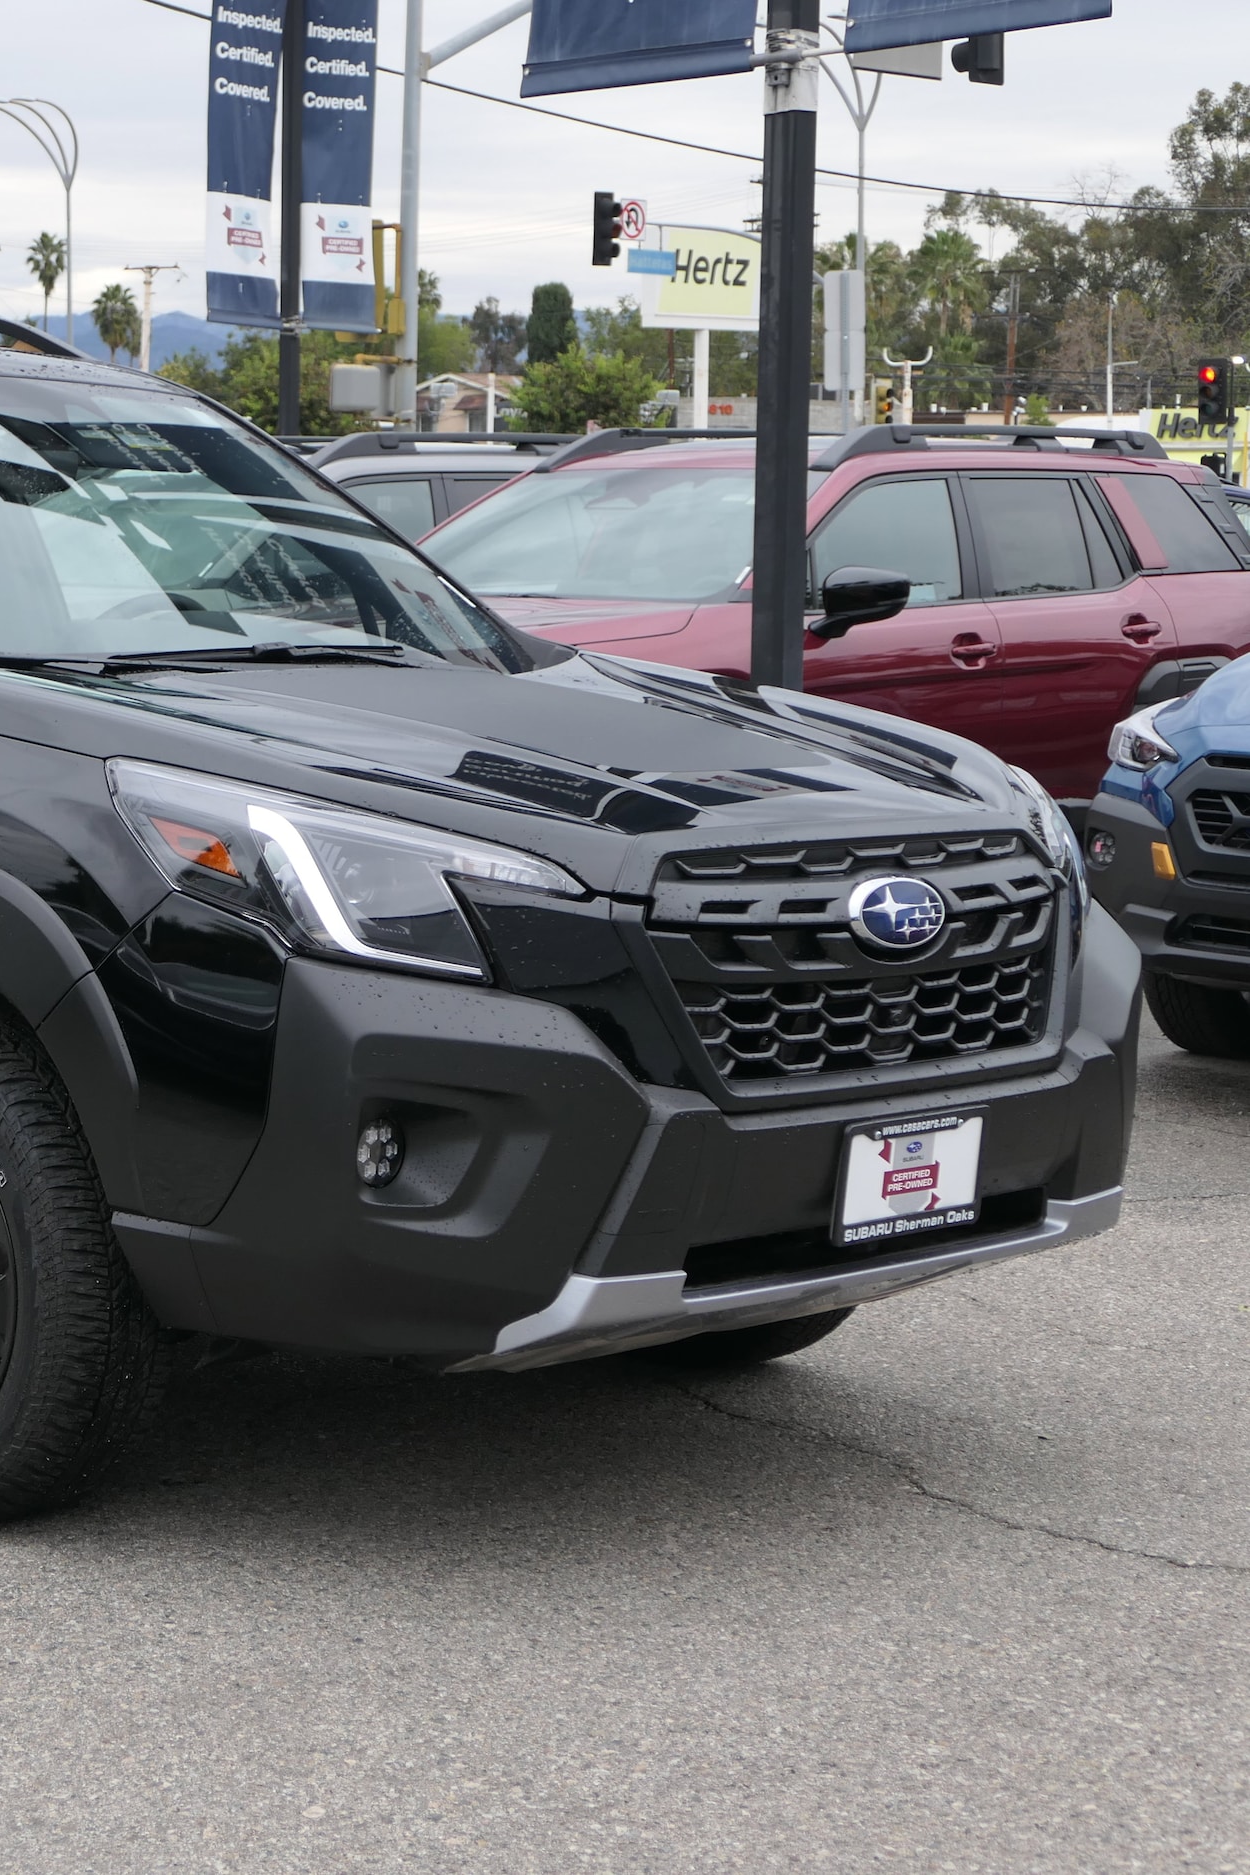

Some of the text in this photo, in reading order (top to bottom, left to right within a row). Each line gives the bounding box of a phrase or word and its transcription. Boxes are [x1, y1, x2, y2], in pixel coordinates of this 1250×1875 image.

[217, 5, 283, 34] Inspected.
[307, 21, 376, 44] Inspected.
[215, 41, 274, 68] Certified.
[305, 56, 370, 77] Certified.
[214, 77, 270, 102] Covered.
[302, 91, 367, 111] Covered.
[671, 248, 750, 287] Hertz
[887, 1178, 933, 1192] PRE-OWNED
[892, 1169, 931, 1182] CERTIFIED
[844, 1210, 975, 1243] SUBARU Sherman Oaks
